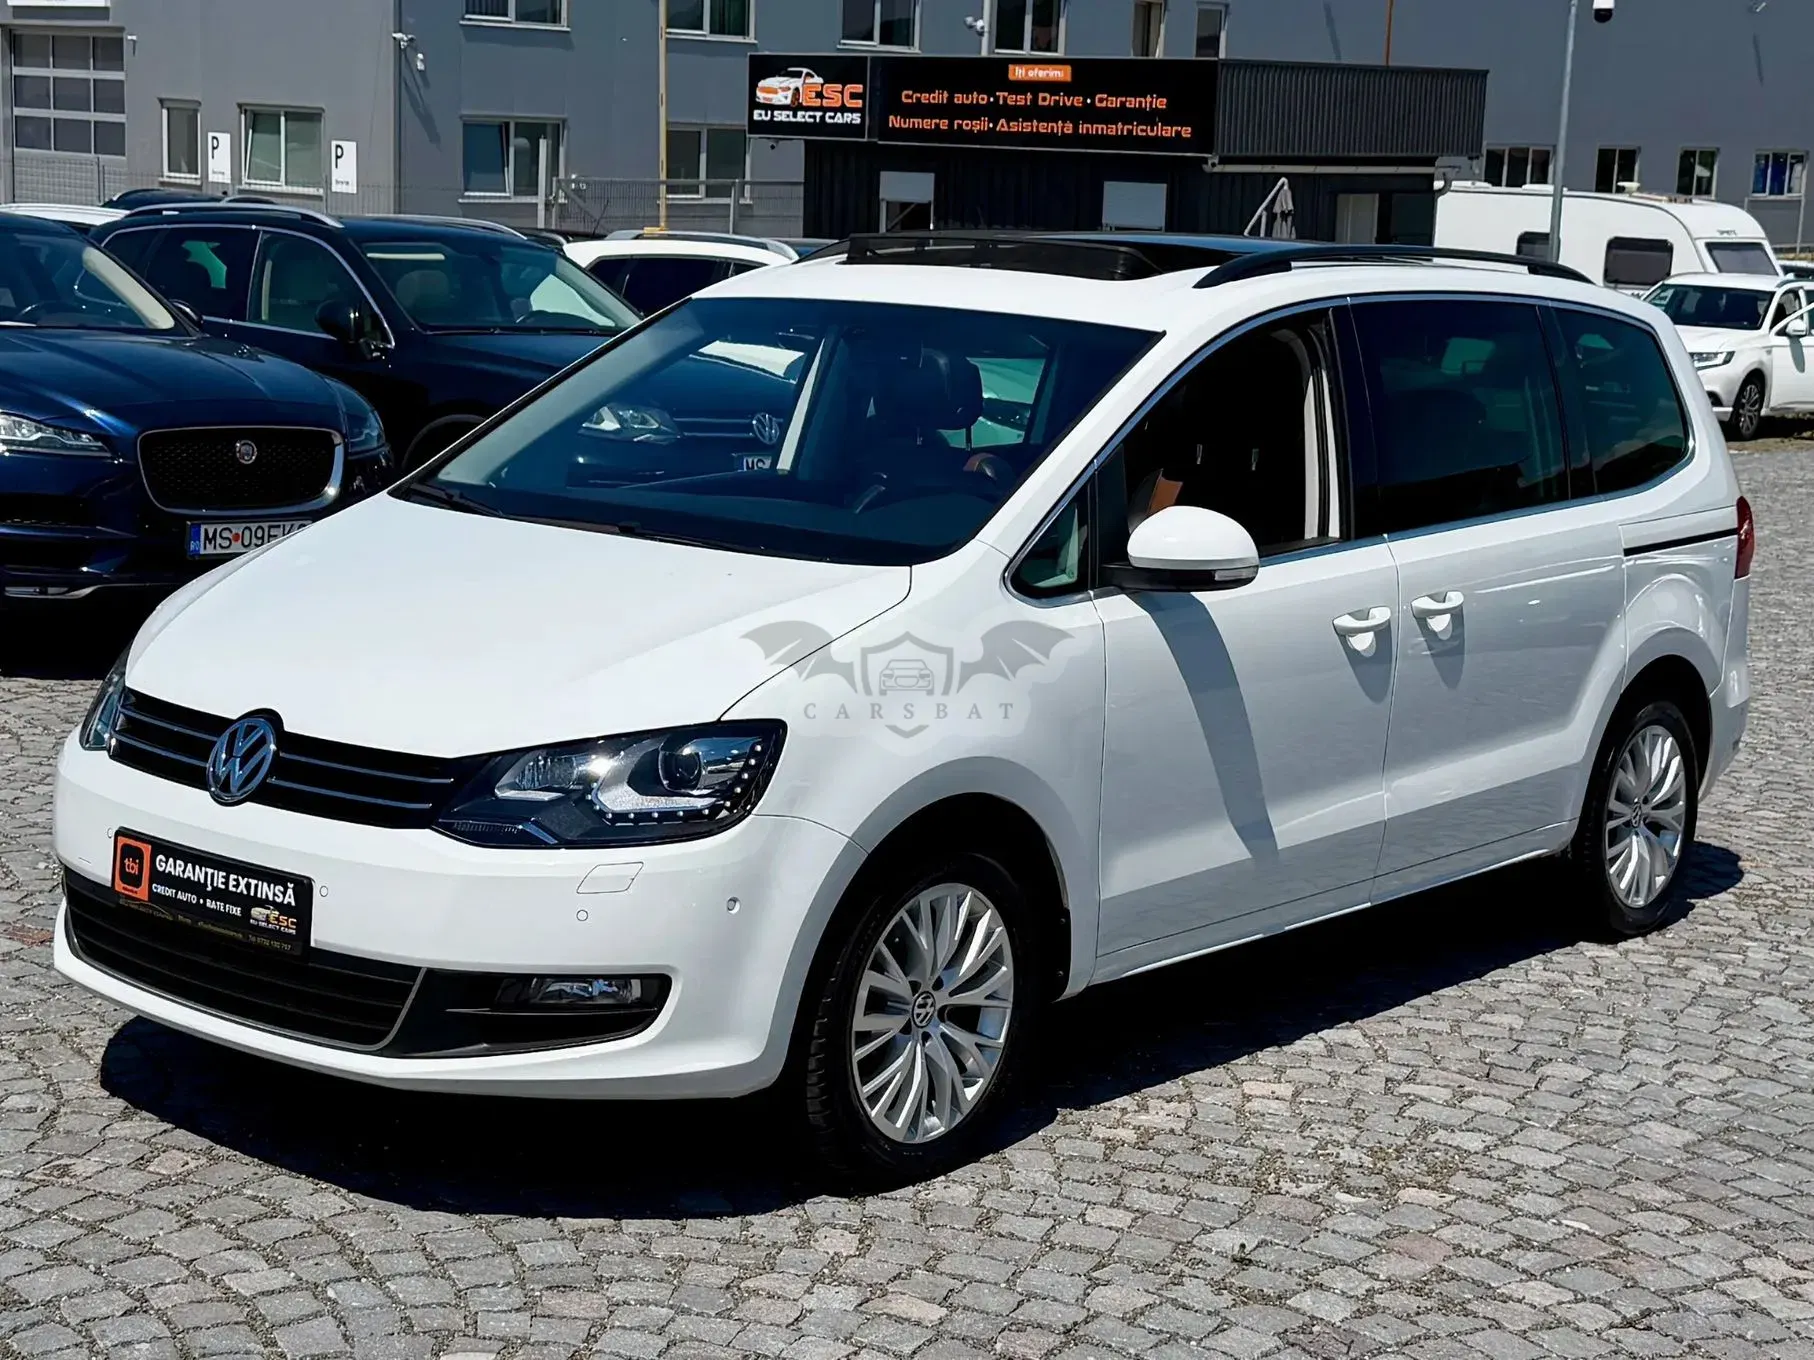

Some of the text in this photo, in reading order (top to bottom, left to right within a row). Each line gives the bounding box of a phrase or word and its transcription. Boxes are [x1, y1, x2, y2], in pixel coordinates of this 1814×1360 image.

[802, 84, 864, 107] ESC
[901, 90, 949, 104] Credit
[954, 91, 988, 104] auto
[996, 91, 1032, 105] Test
[1038, 92, 1083, 106] Drive
[753, 109, 861, 124] EU SELECT CARS
[888, 115, 949, 129] Numere
[1078, 120, 1192, 138] inmatriculare
[211, 135, 220, 160] P
[335, 144, 344, 169] P
[124, 857, 139, 876] tbi
[152, 883, 177, 899] CREDIT
[176, 890, 198, 904] AUTO
[205, 898, 225, 913] RATE
[225, 903, 242, 917] FIXE
[228, 873, 296, 907] EXTINSĂ
[269, 911, 298, 929] ESC
